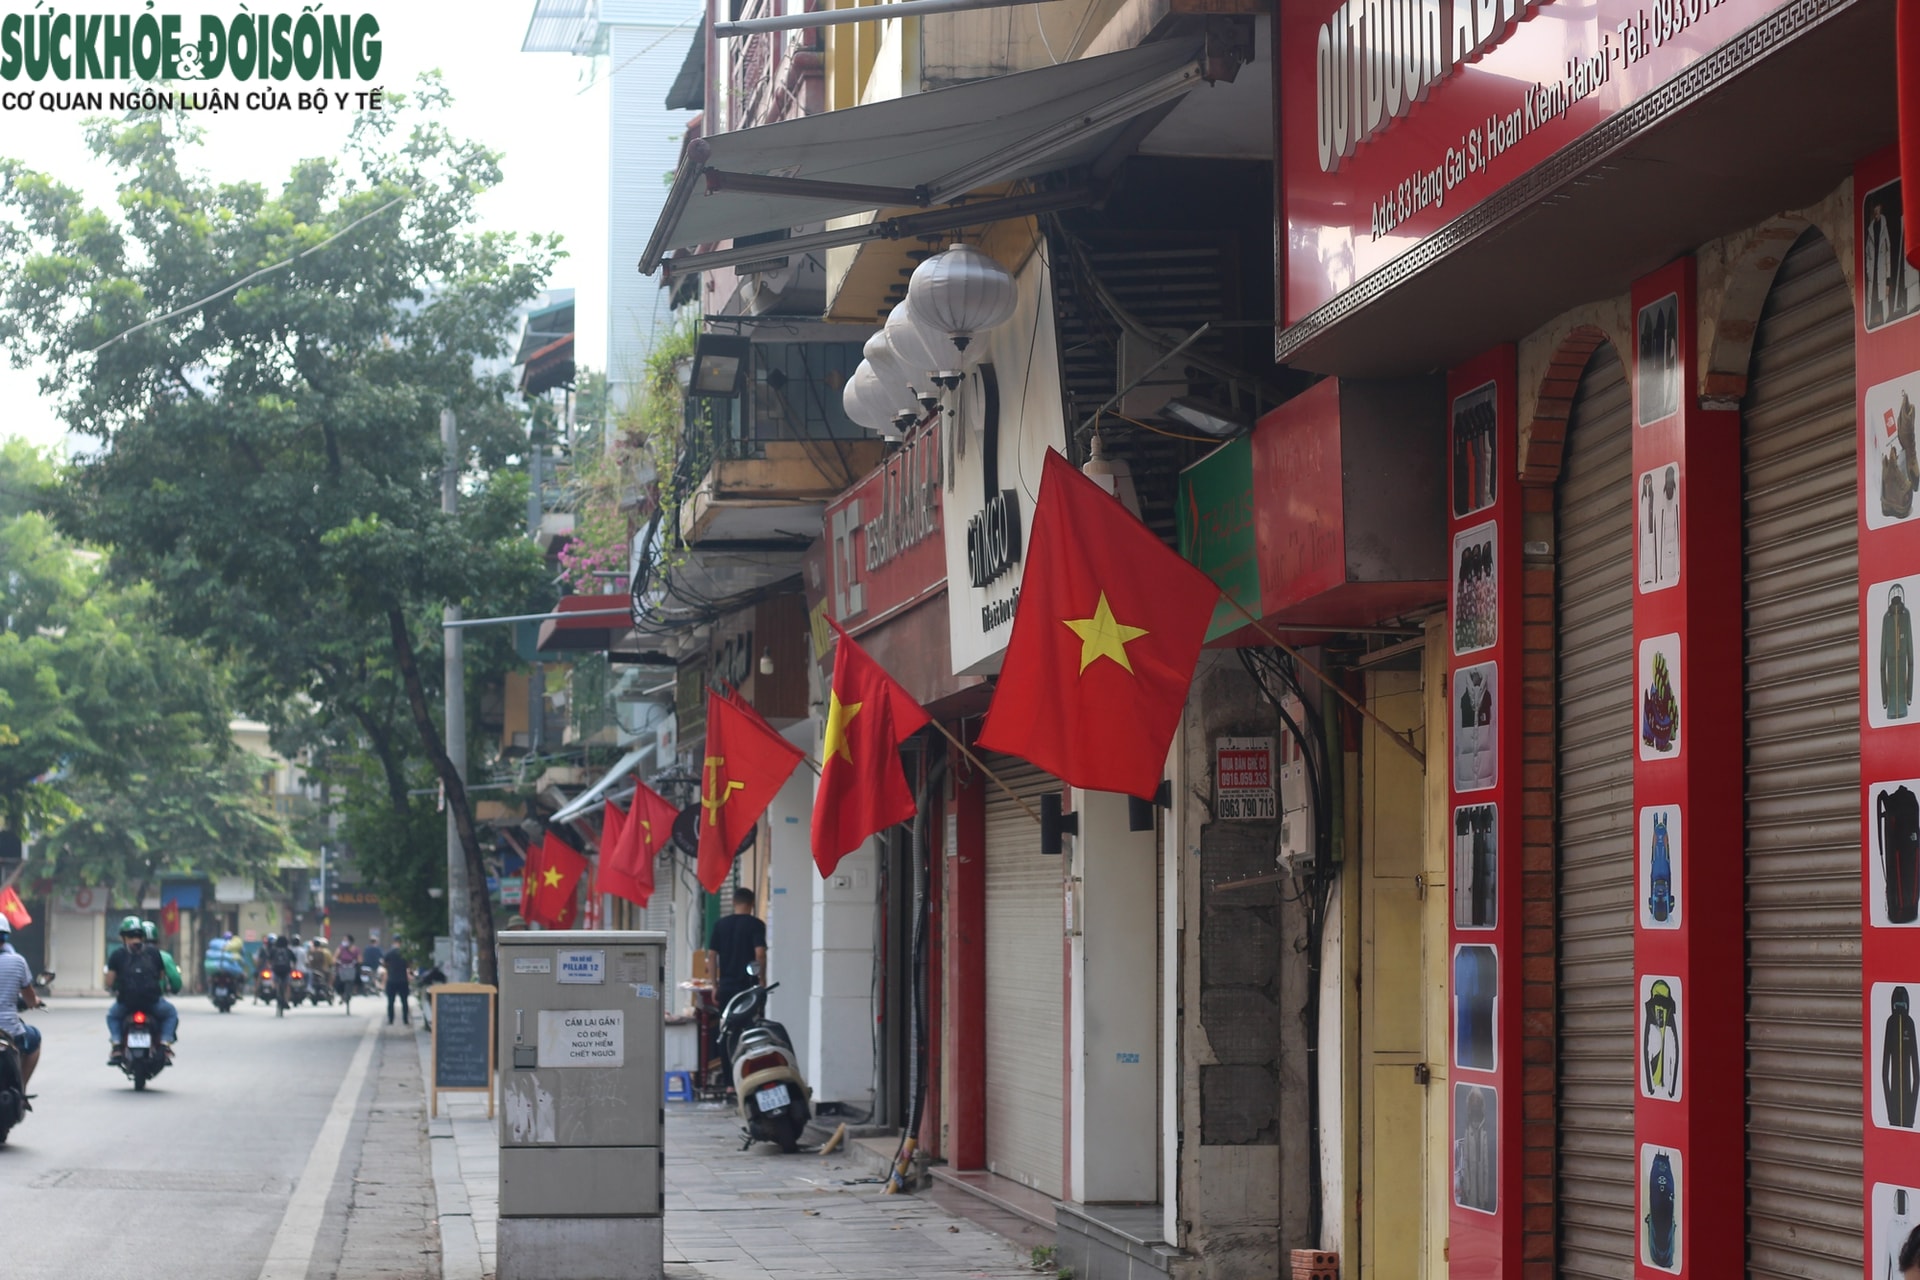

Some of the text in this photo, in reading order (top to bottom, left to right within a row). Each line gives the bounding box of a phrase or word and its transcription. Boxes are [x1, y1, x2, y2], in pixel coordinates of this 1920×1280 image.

[1372, 190, 1397, 242] Add:
[1397, 178, 1412, 223] 83
[1413, 165, 1443, 213] Hang
[1445, 136, 1466, 190] Gai
[1469, 126, 1486, 174] St,
[1487, 108, 1523, 160] Hoan
[1618, 9, 1650, 69] Tel:
[563, 963, 588, 971] PILLAR
